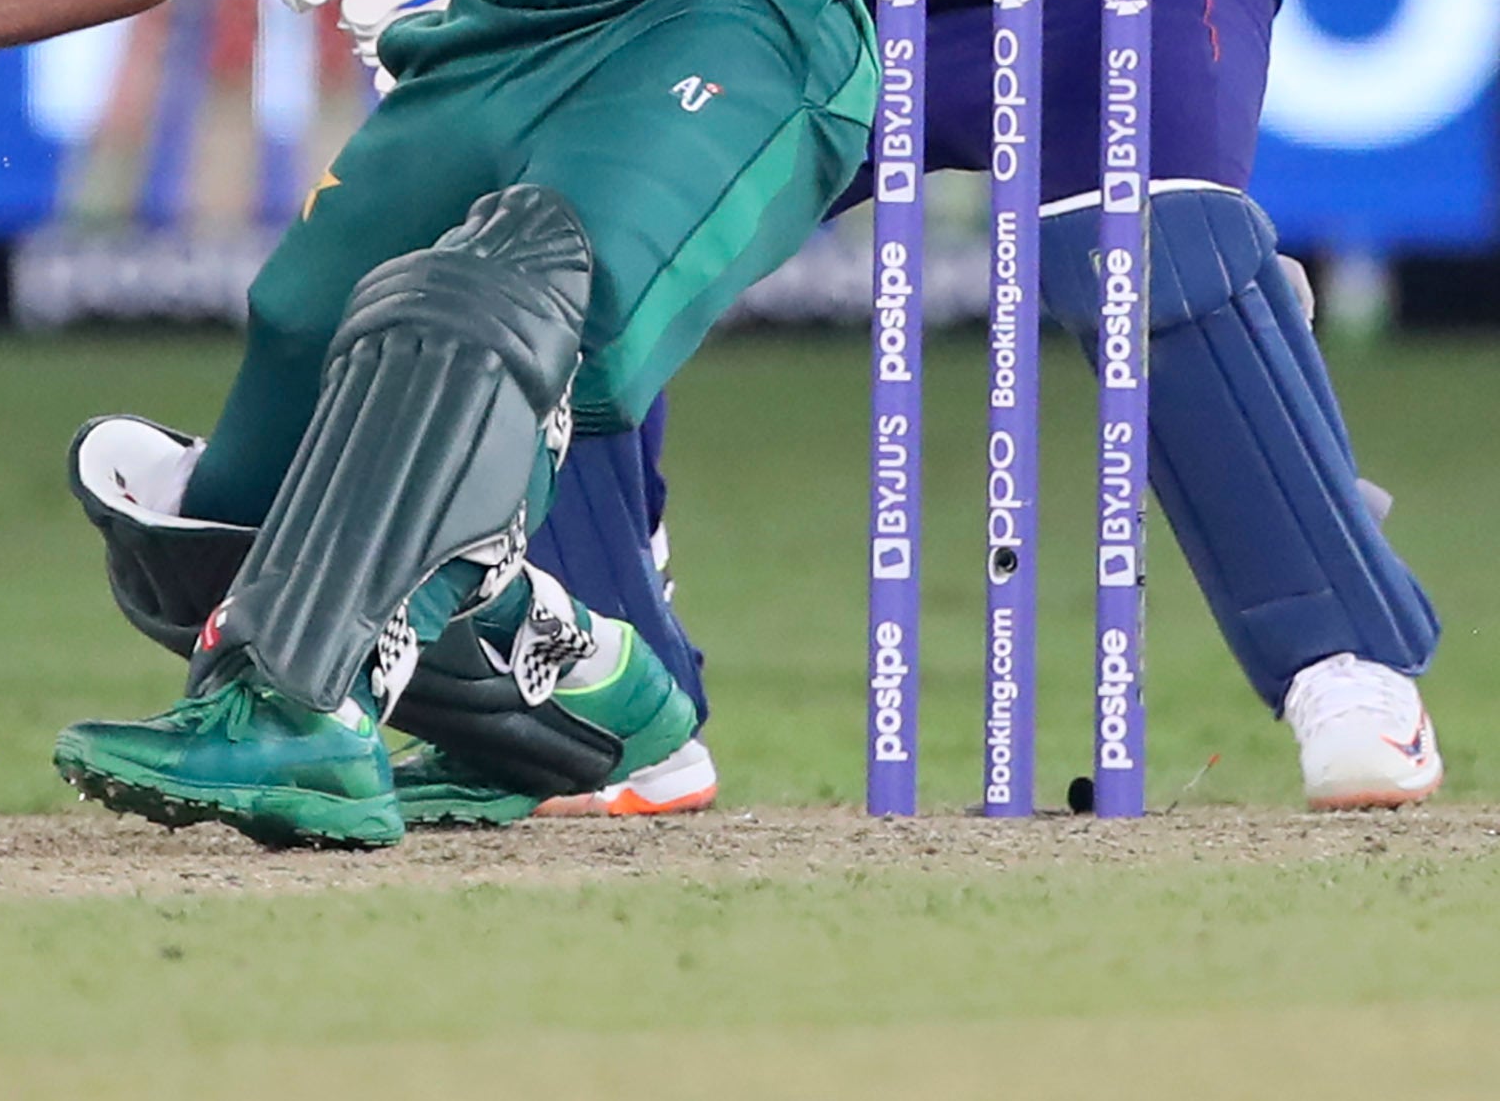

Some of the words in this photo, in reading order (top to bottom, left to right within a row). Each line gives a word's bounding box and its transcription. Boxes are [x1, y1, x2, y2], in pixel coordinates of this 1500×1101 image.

[882, 37, 915, 157] BYJU'S
[992, 28, 1027, 182] oppo
[1107, 47, 1139, 167] BYJU'S
[875, 240, 914, 382] postpe
[991, 210, 1023, 408] Booking.com
[1101, 247, 1139, 389] postpe
[877, 413, 909, 534] BYJU'S
[988, 430, 1023, 585] oppo
[1101, 421, 1133, 541] BYJU'S
[871, 620, 909, 762] postpe
[986, 607, 1018, 804] Booking.com
[1097, 627, 1134, 770] postpe
